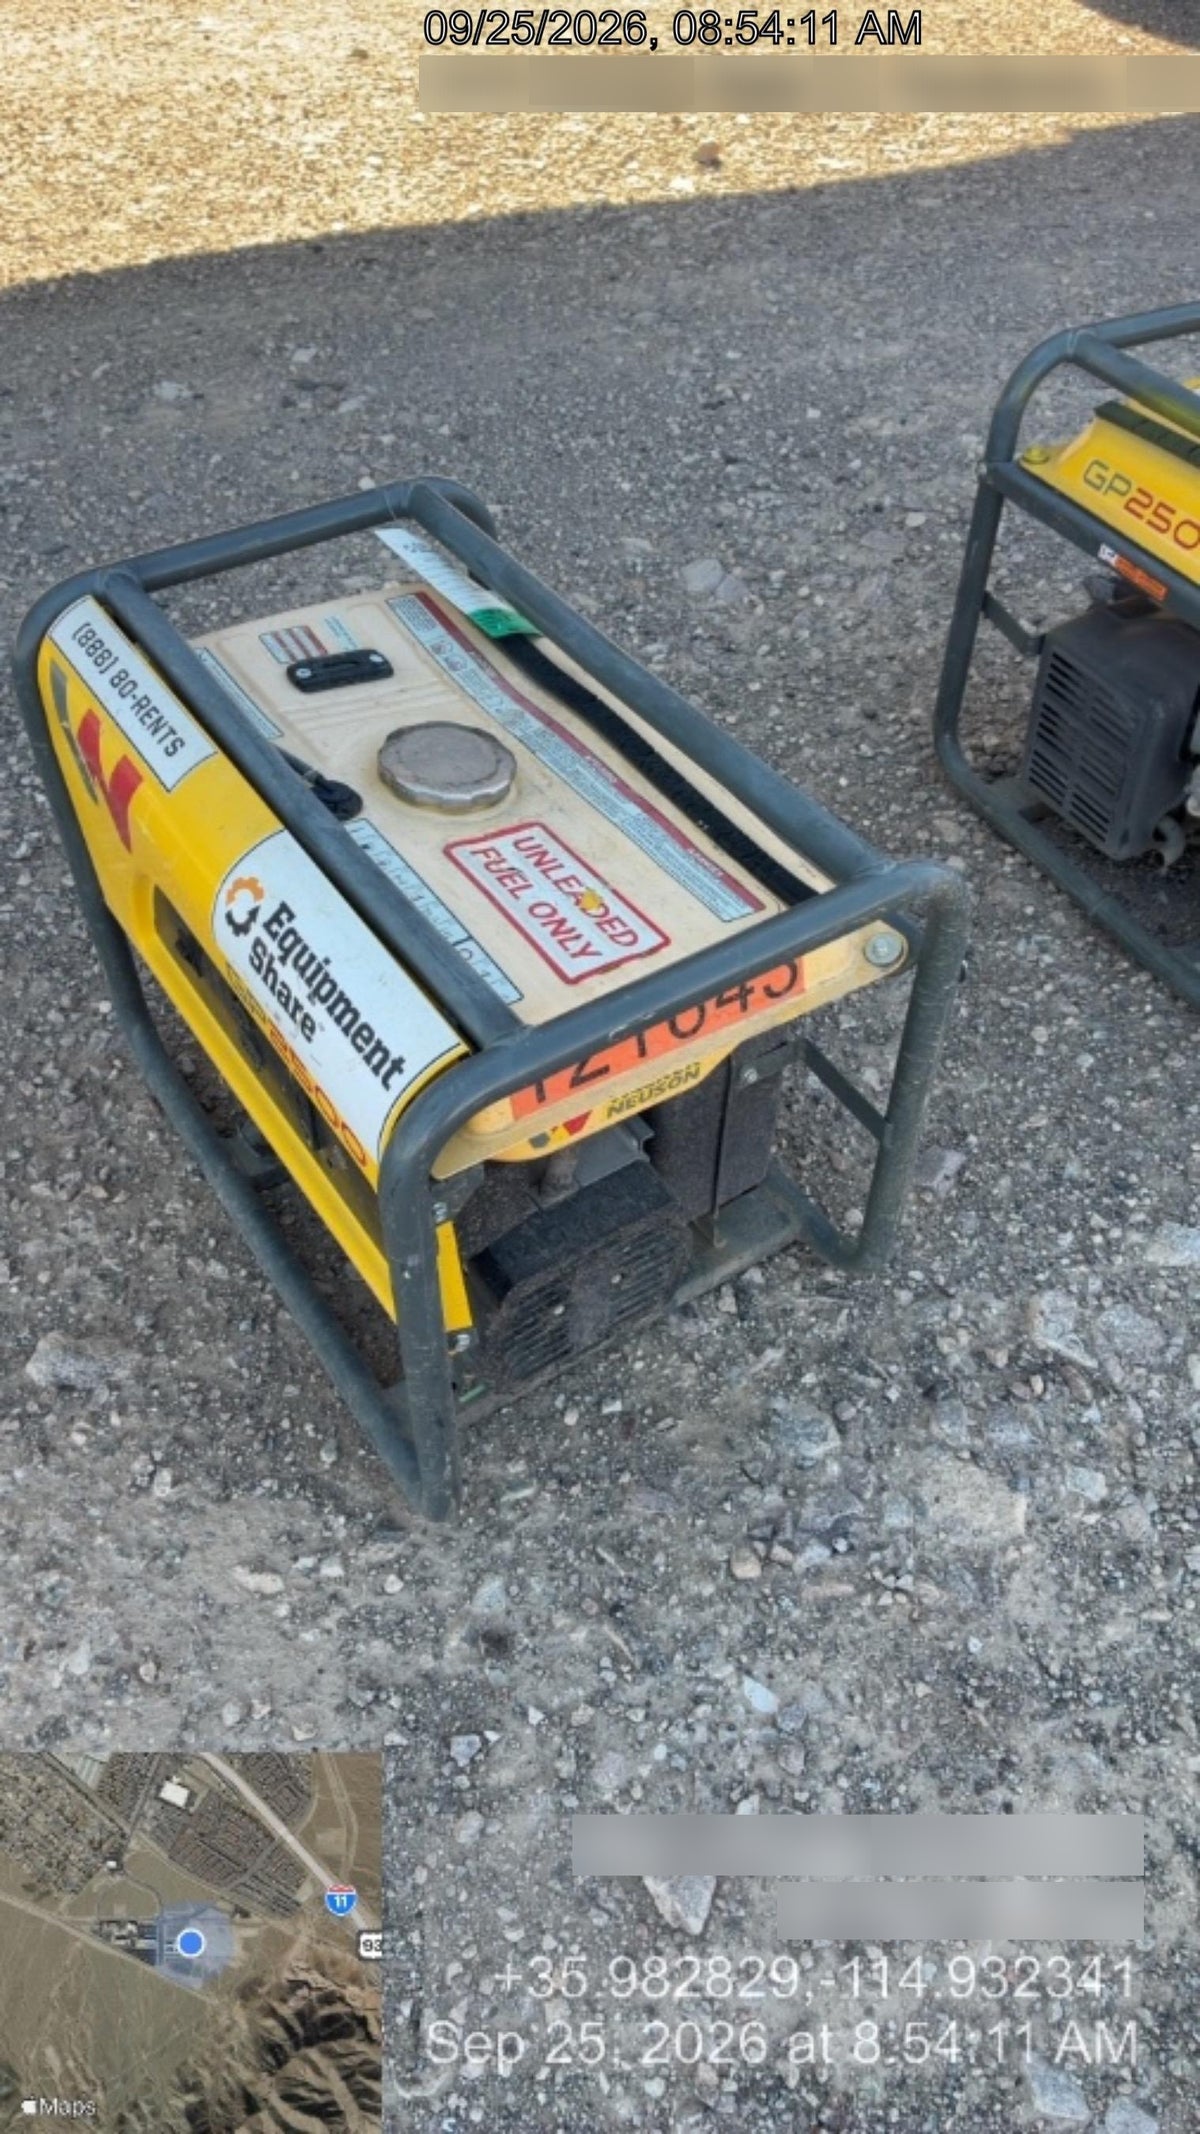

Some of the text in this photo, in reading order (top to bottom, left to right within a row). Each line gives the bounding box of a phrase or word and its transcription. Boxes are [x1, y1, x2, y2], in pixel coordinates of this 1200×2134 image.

[72, 622, 186, 758] (888) 80-RENTS
[470, 846, 534, 901] FUEL
[528, 901, 603, 959] ONLY
[512, 836, 639, 947] UNLEADED
[248, 936, 318, 1044] Share
[262, 900, 406, 1091] Equipment
